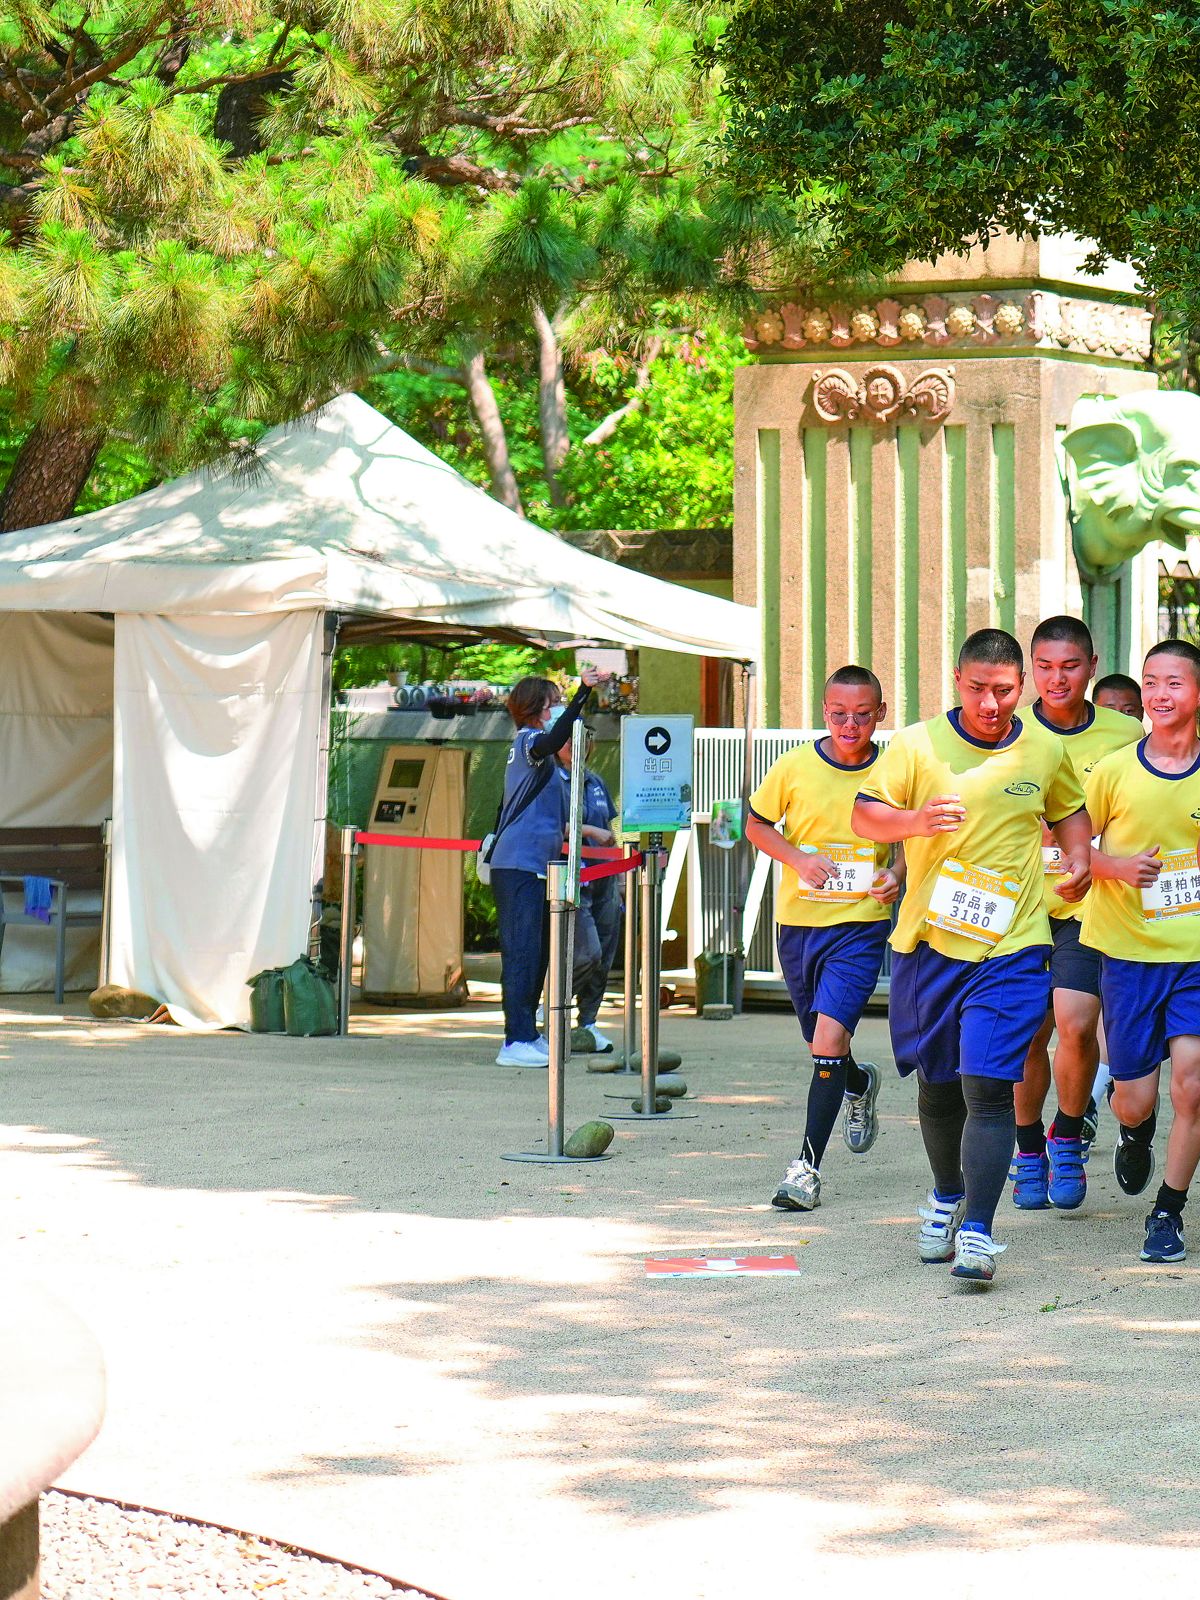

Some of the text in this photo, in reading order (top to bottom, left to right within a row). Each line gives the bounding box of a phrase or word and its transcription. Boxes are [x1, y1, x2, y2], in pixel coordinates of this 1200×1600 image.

[644, 757, 672, 773] 出口
[952, 890, 997, 915] 邱品睿
[949, 905, 990, 928] 3180
